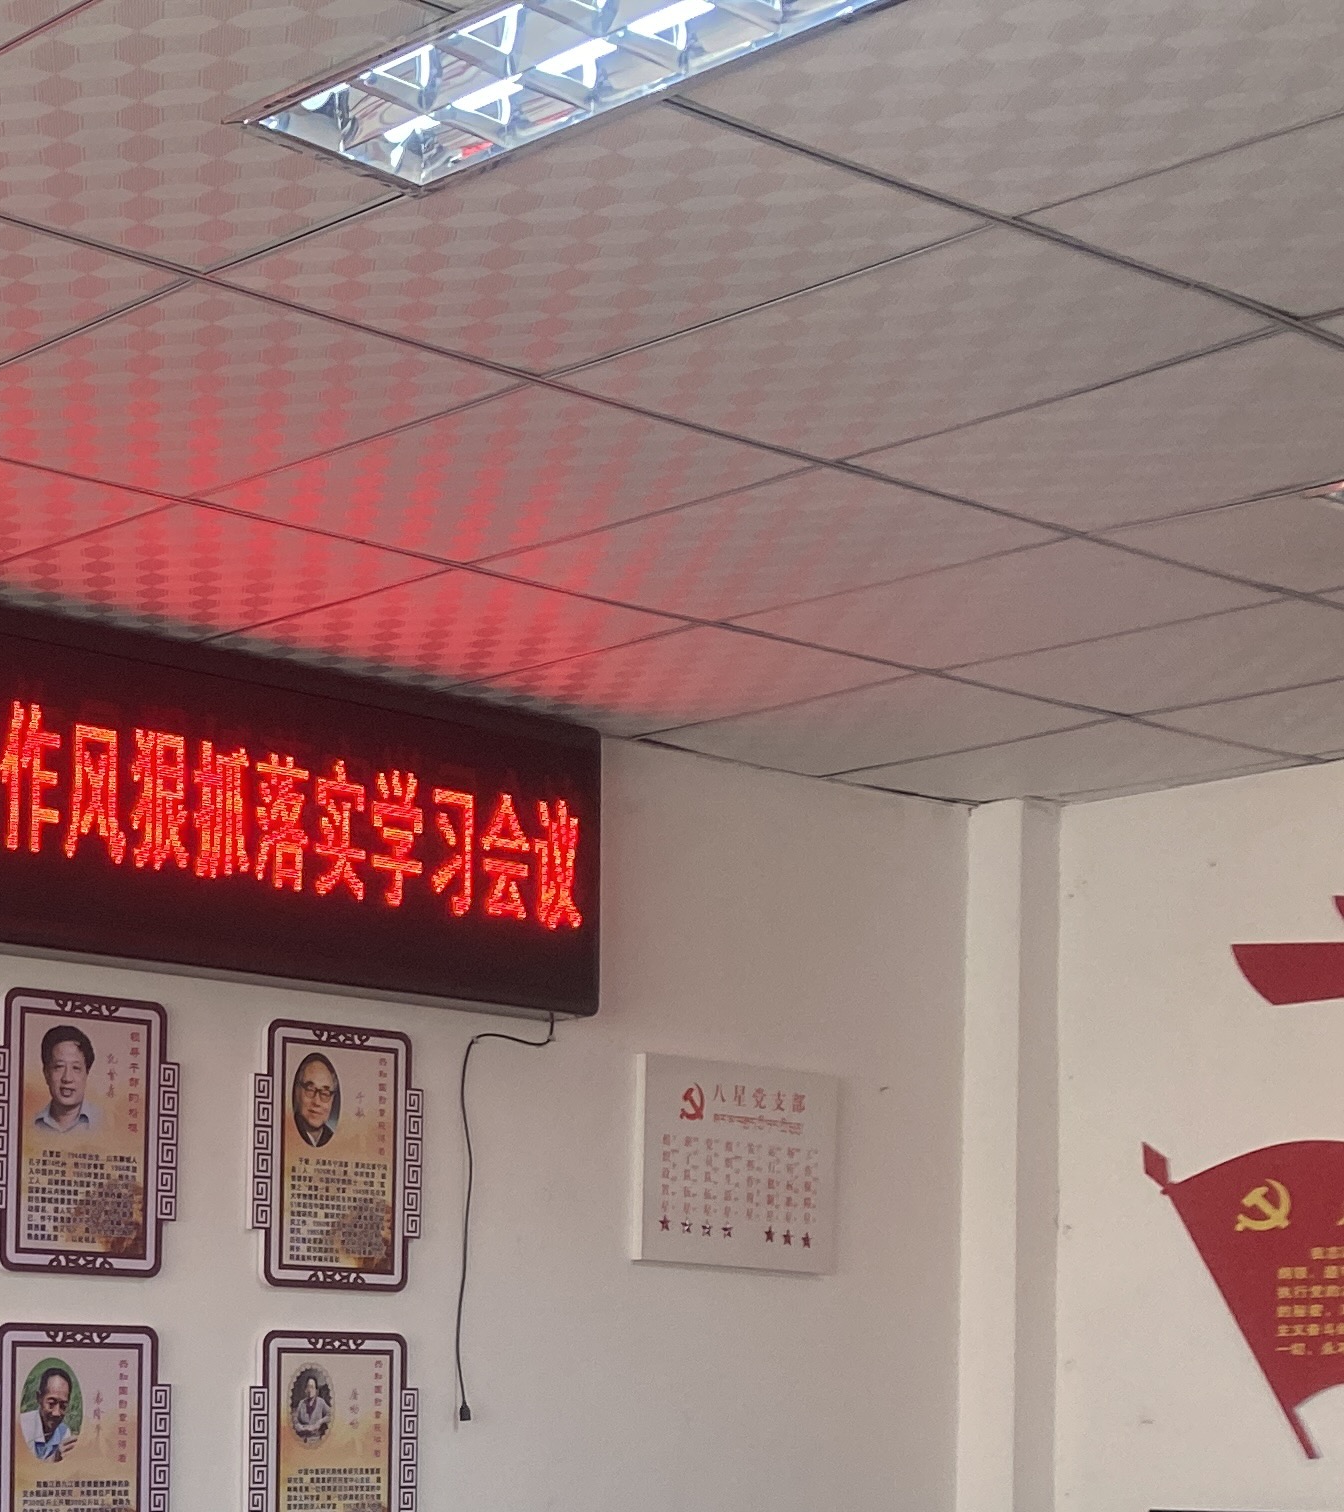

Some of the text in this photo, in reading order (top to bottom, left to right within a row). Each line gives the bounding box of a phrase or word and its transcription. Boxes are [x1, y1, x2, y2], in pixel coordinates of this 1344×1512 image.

[713, 1084, 806, 1113] 八星党支部
